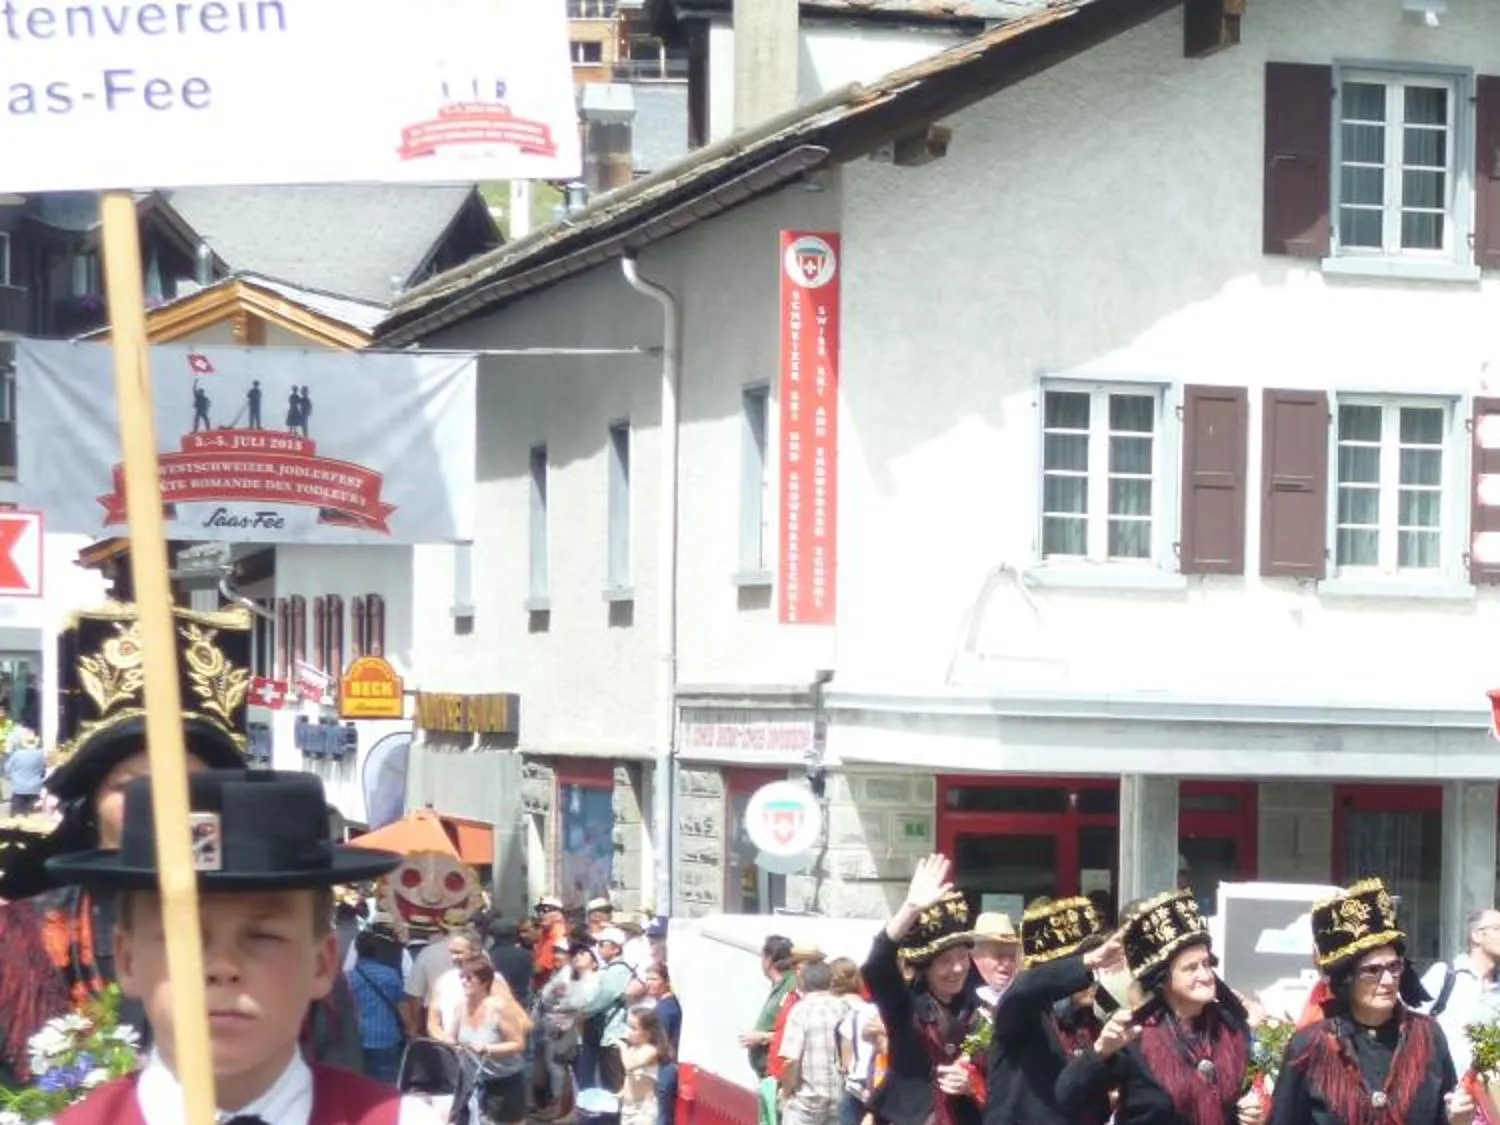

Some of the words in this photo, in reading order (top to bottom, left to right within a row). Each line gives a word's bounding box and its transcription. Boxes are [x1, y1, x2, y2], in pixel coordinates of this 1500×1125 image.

[2, 0, 287, 39] tenverein
[8, 69, 212, 115] as-Fee
[231, 435, 265, 449] JULI
[351, 681, 393, 696] BECK
